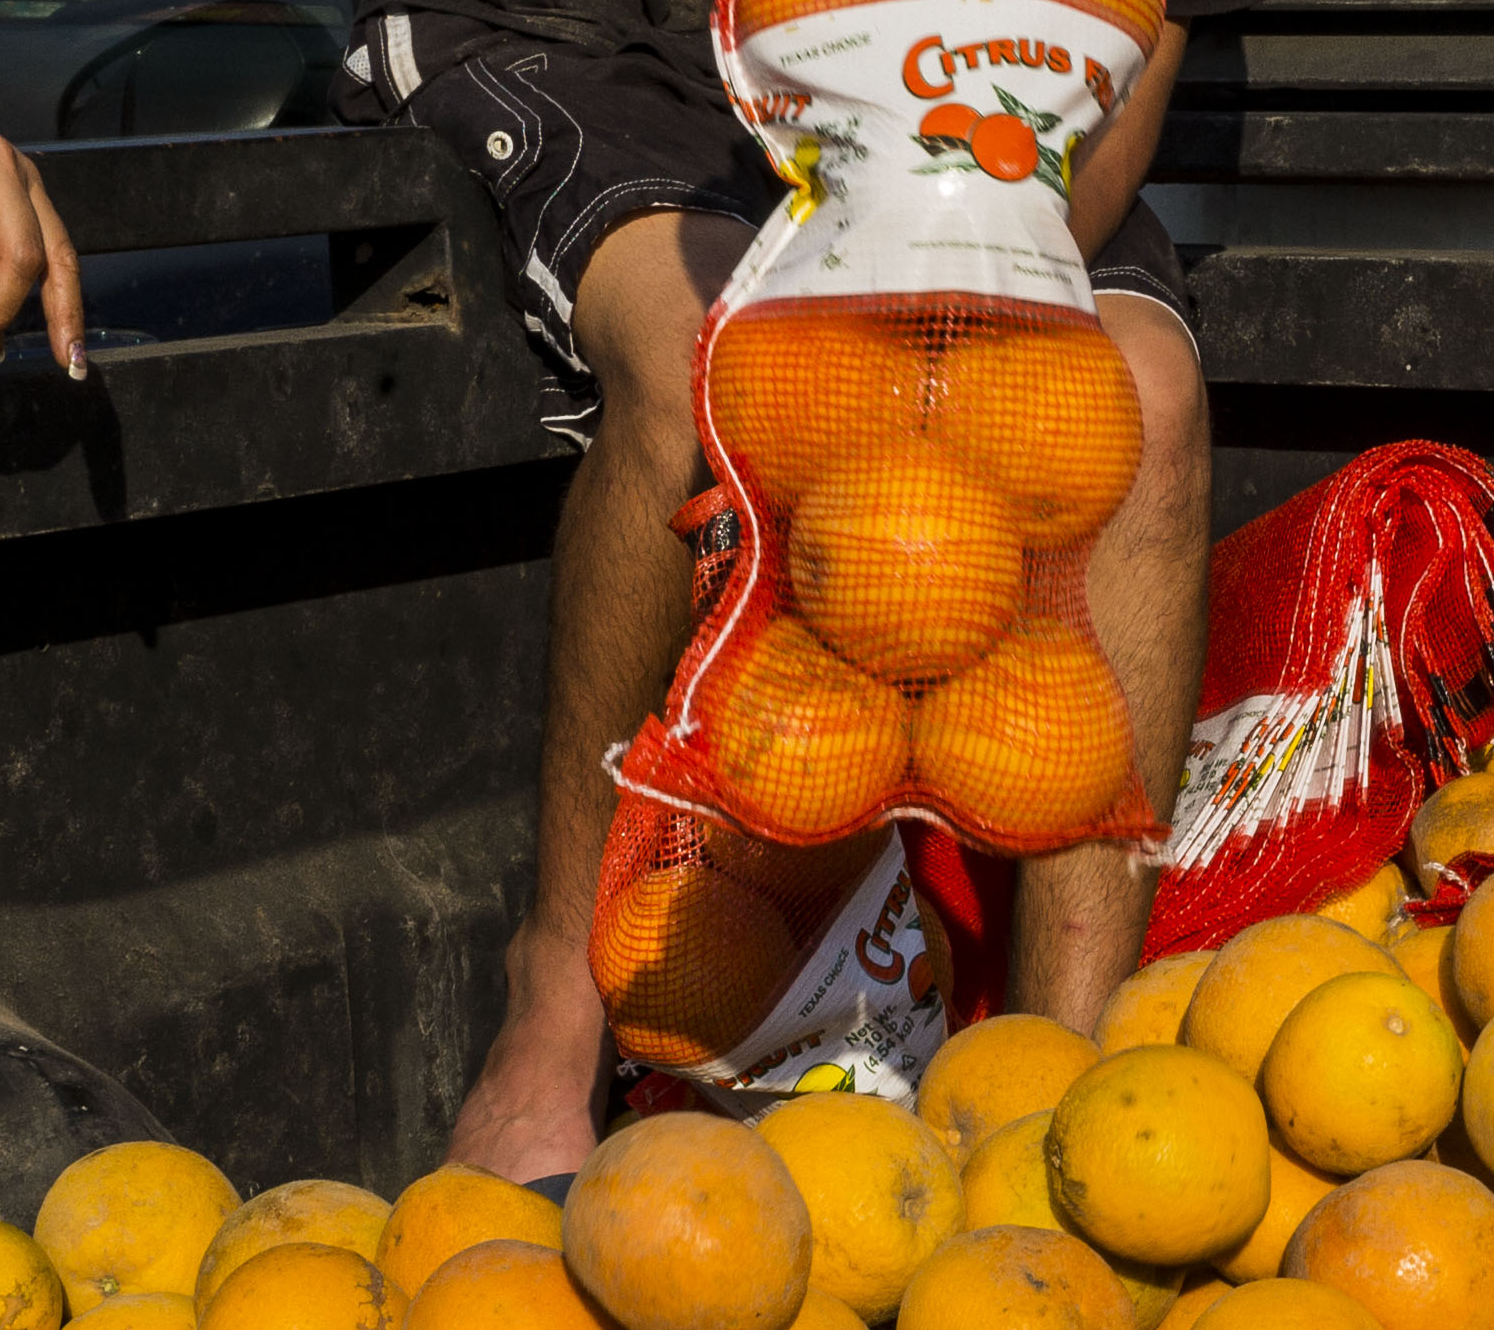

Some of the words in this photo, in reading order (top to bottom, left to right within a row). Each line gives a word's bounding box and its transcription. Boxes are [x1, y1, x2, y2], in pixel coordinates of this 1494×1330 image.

[902, 35, 1072, 99] CITRUS
[799, 985, 826, 1018] TEXAS
[824, 947, 850, 987] CHOICE
[844, 1023, 874, 1047] Net
[863, 1037, 896, 1074] (4.54
[896, 1015, 915, 1042] kg)
[864, 1030, 883, 1048] 10
[884, 1020, 898, 1035] lb
